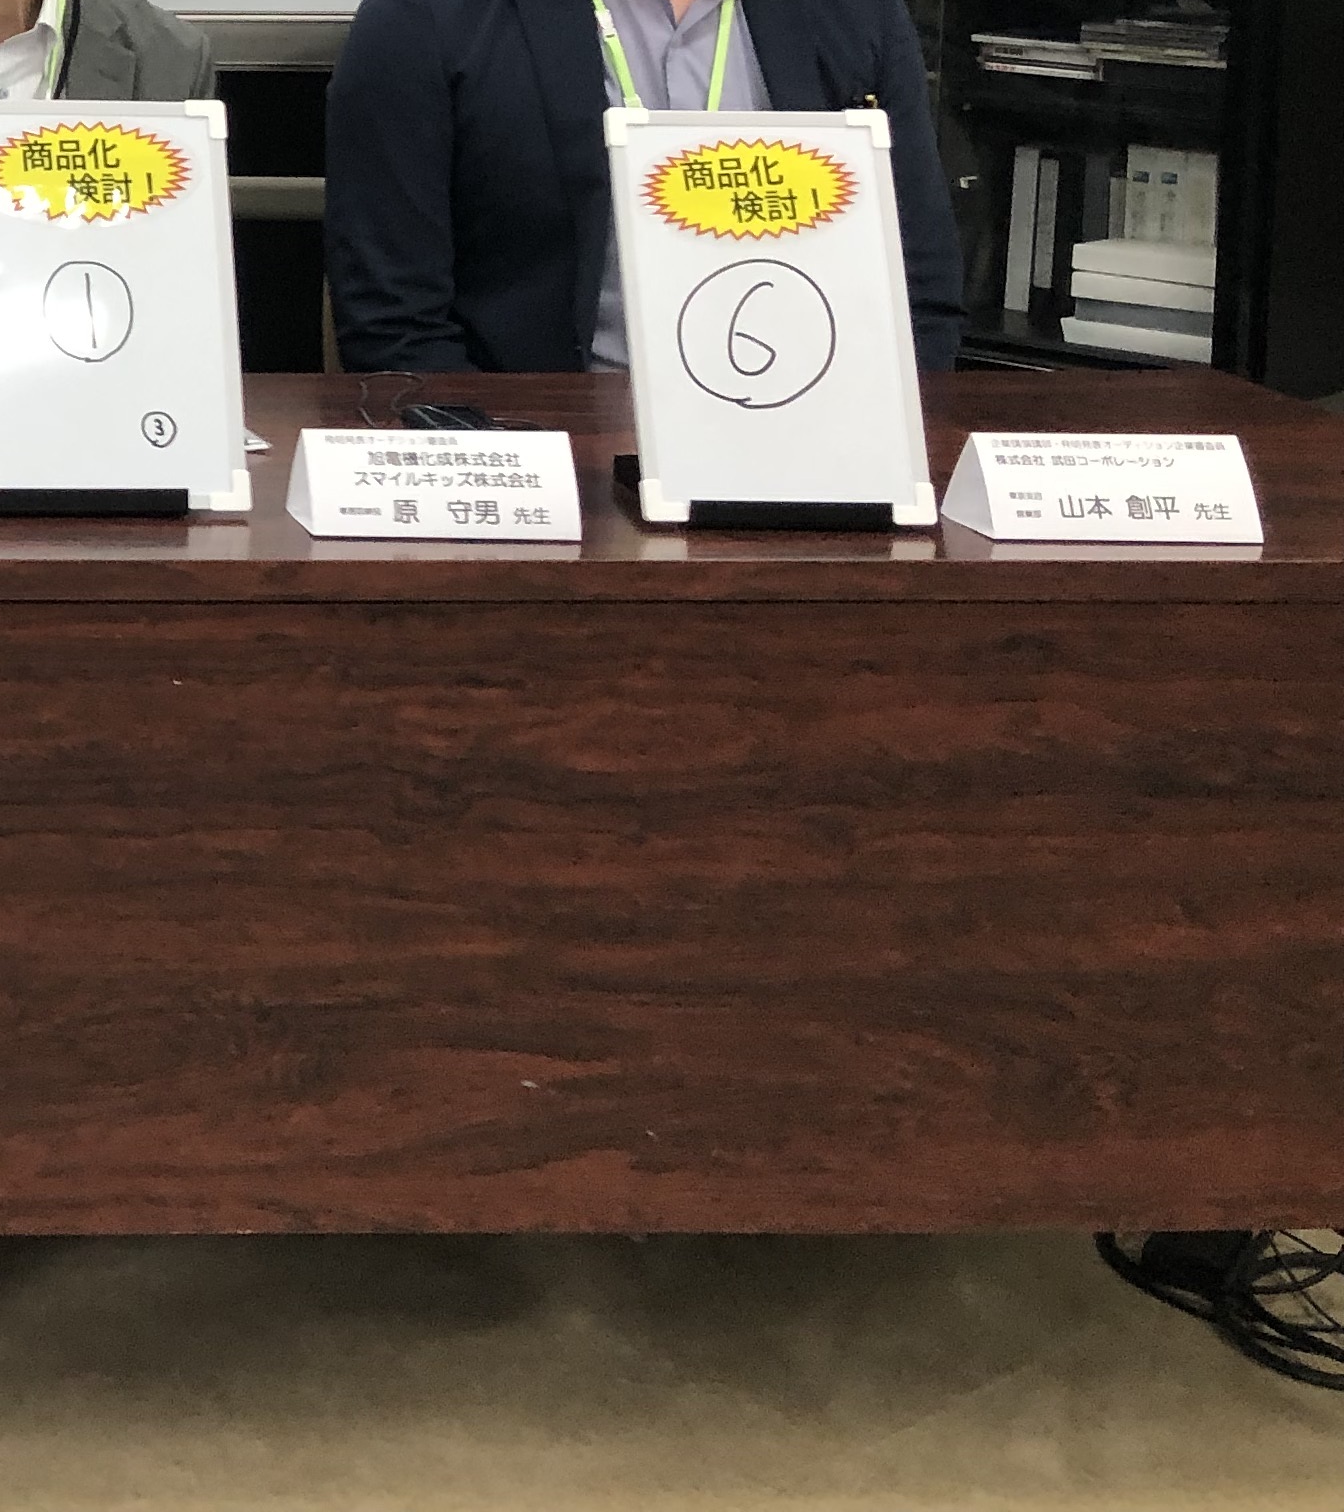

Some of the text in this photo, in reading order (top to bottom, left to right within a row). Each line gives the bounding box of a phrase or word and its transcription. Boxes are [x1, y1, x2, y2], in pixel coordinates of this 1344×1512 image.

[22, 139, 120, 172] 商品化
[681, 156, 784, 191] 商品化
[393, 499, 551, 525] 原 守男 先生
[1059, 495, 1232, 521] 山本 創平 先生
